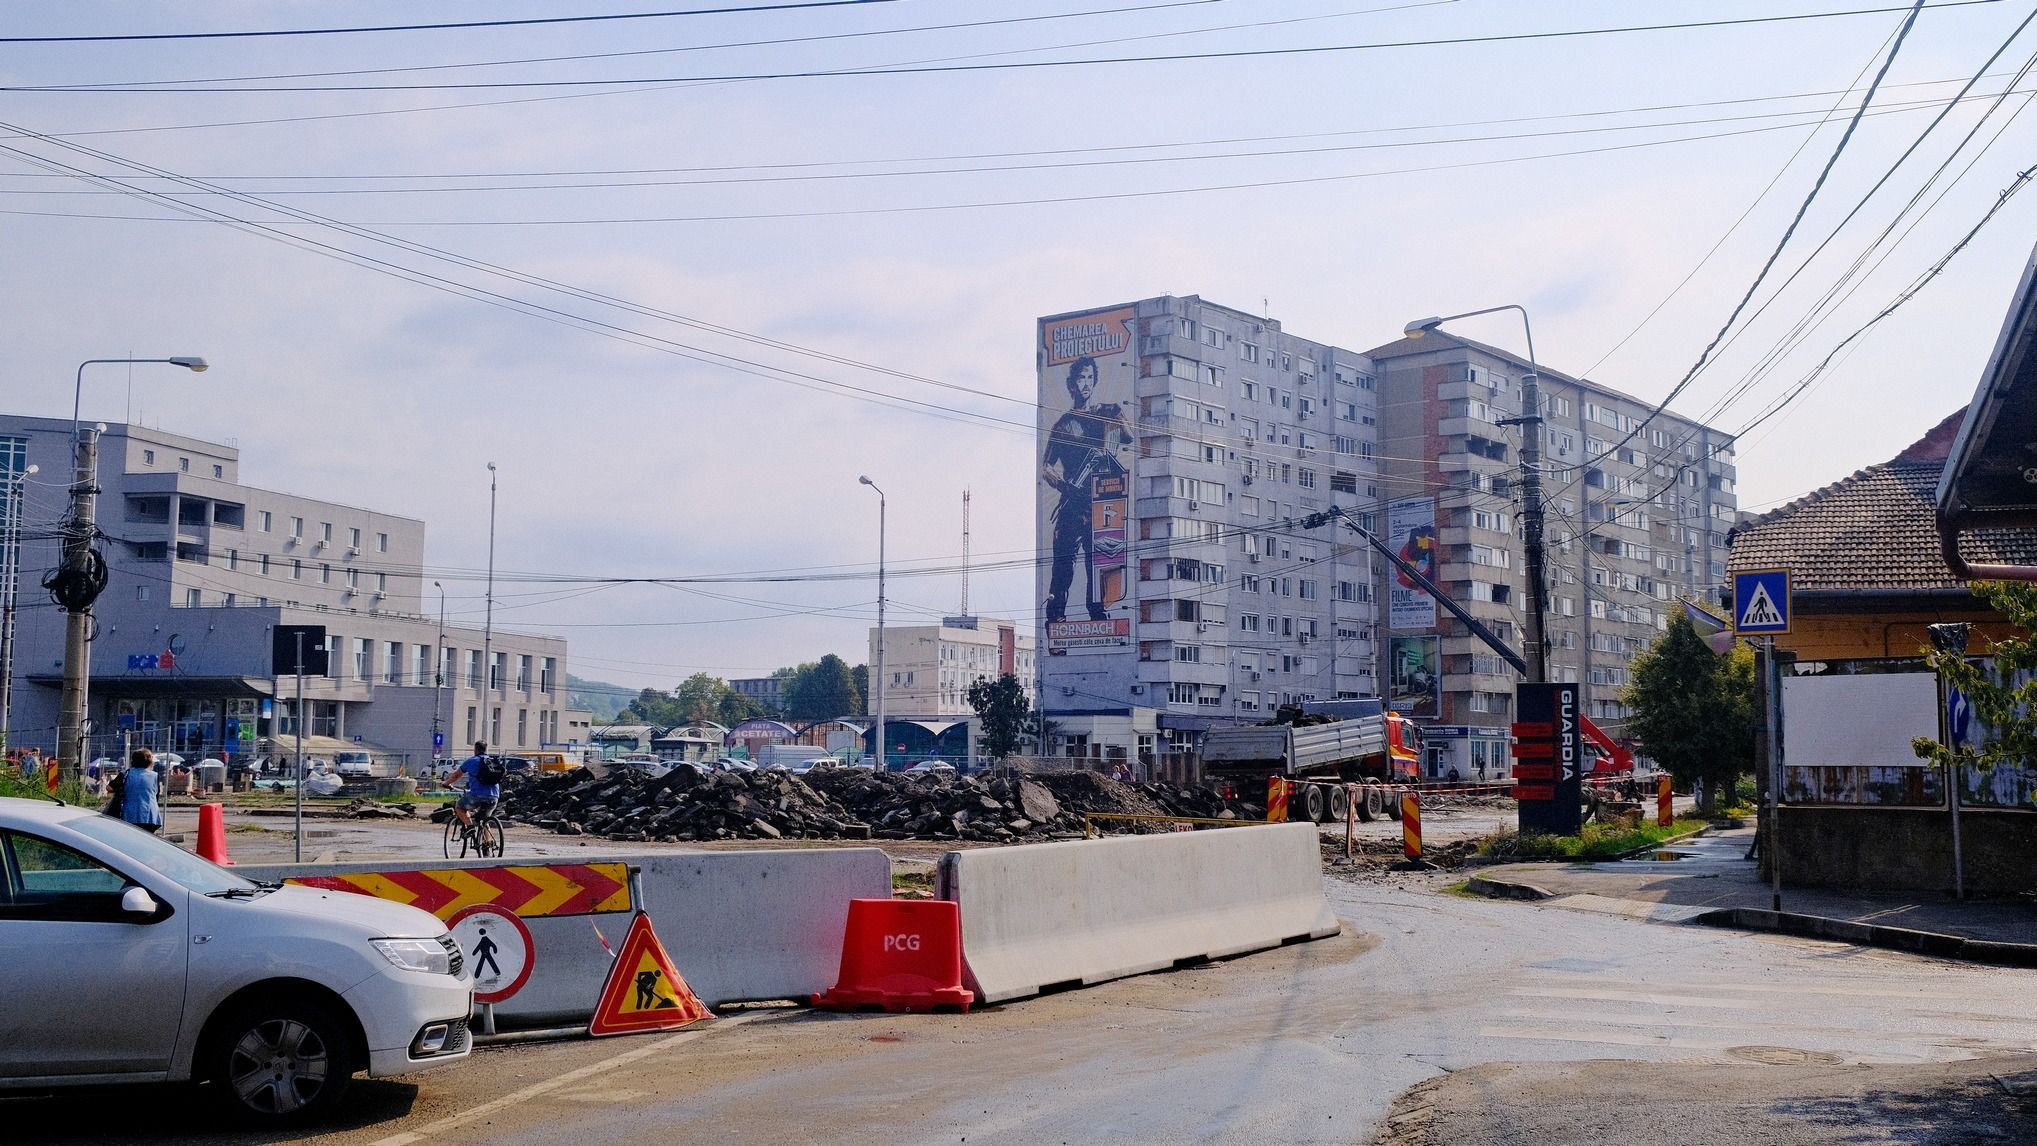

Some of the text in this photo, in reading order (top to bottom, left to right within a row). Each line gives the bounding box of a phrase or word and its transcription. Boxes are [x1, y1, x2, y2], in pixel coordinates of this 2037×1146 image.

[1053, 322, 1107, 341] CHEMAREA
[1053, 332, 1123, 360] PROIECTULUI
[1391, 590, 1413, 602] FILME
[1050, 622, 1114, 637] HORNBACH
[740, 730, 782, 738] CETATE
[1560, 690, 1574, 782] GUARDIA
[884, 933, 921, 952] PCG
